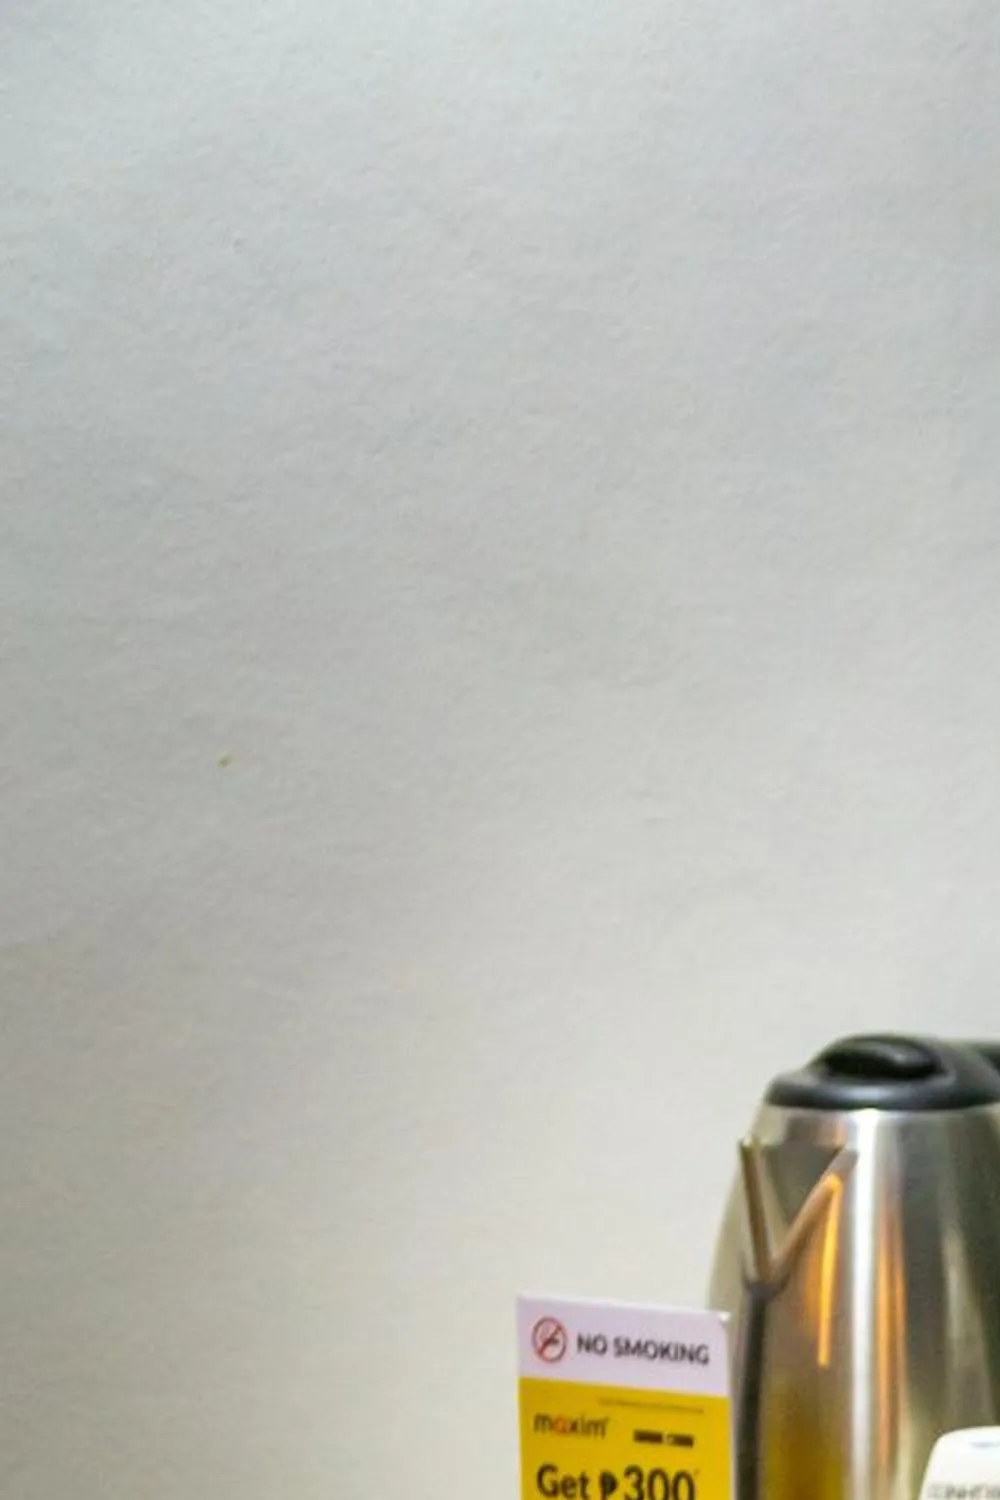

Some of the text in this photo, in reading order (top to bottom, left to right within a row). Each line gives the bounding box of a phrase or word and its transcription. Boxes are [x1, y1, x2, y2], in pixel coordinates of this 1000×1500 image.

[576, 1333, 710, 1366] NO SMOKING
[533, 1413, 610, 1440] maxim
